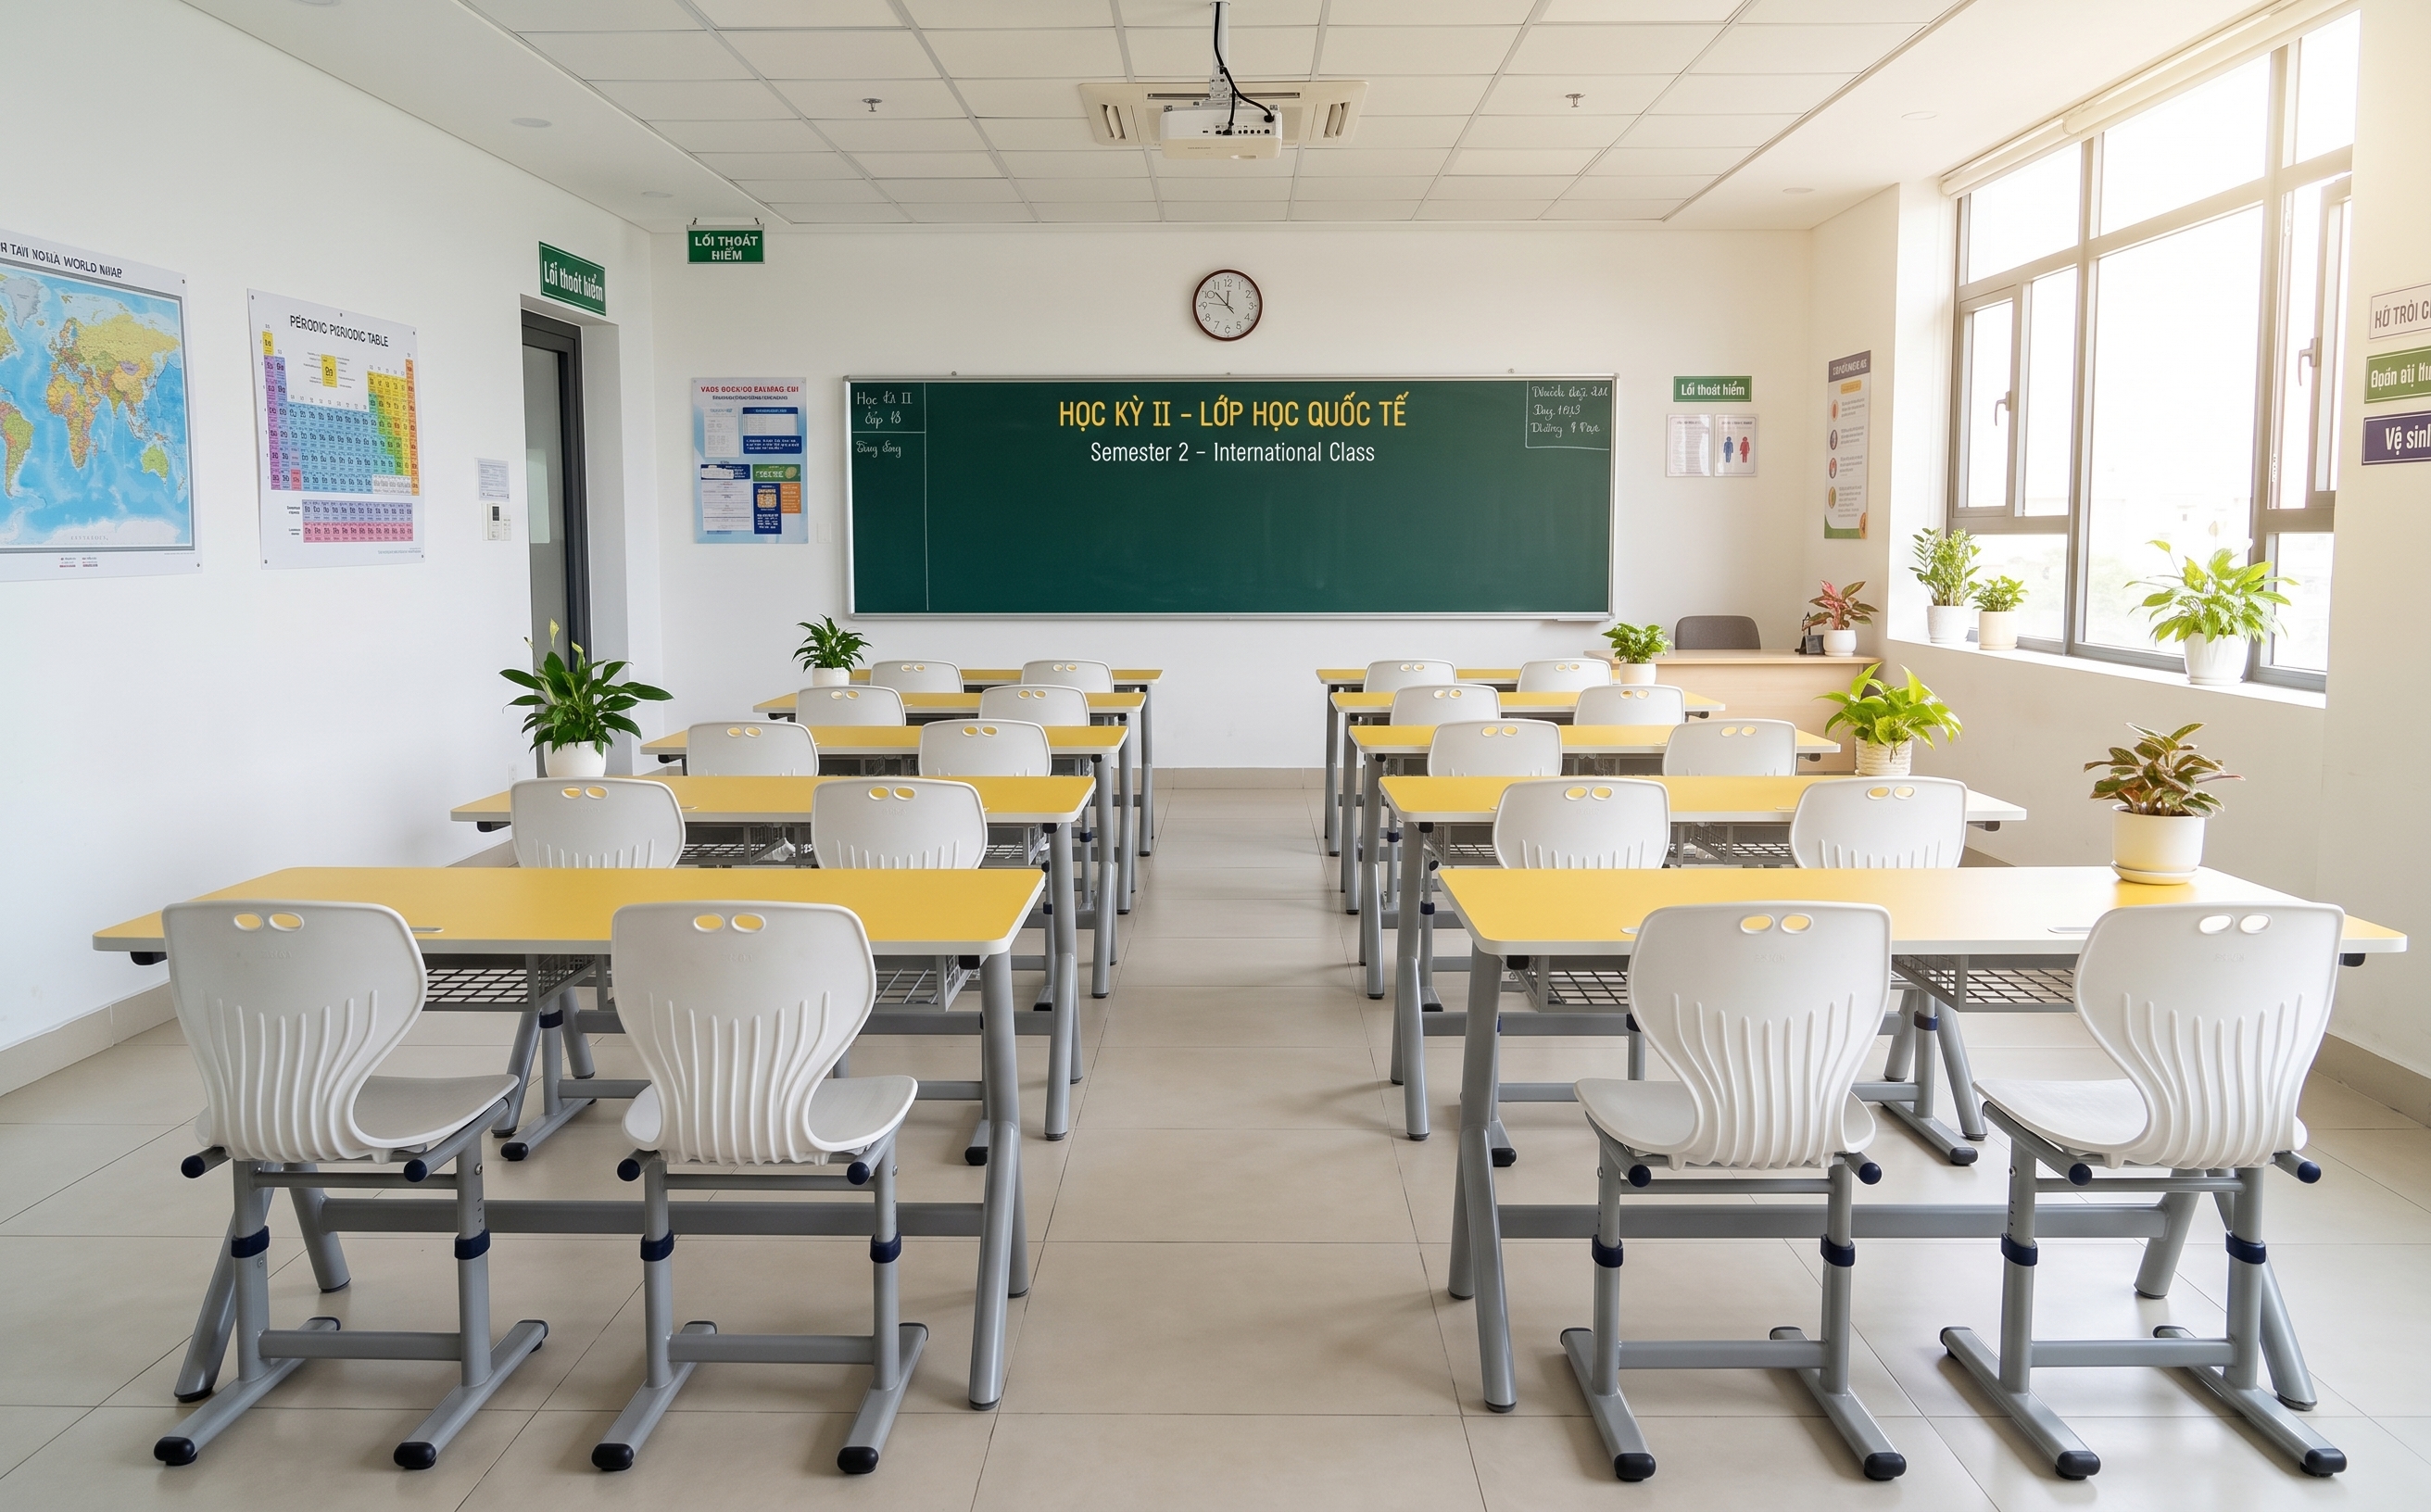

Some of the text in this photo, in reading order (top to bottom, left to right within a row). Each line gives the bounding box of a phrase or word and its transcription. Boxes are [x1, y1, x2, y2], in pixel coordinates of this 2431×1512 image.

[695, 233, 758, 246] LỐI THOÁT
[63, 256, 97, 273] WORLD
[560, 268, 582, 295] thoát
[1215, 282, 1220, 290] 11
[1224, 279, 1233, 287] 12
[1204, 290, 1216, 298] 10
[1245, 290, 1252, 298] 2
[2422, 300, 2431, 320] C
[1205, 313, 1211, 321] 8
[1244, 313, 1250, 321] 4
[1215, 321, 1220, 329] 7
[367, 332, 389, 347] TABLE
[1697, 384, 1721, 396] thoát
[857, 391, 878, 409] Học
[1059, 400, 1106, 432] HỌC
[1115, 395, 1144, 427] KỲ
[1153, 401, 1171, 427] II
[1201, 394, 1243, 427] LỚP
[1253, 400, 1299, 432] HỌC
[1307, 391, 1371, 428] QUỐC
[1379, 391, 1409, 427] TẾ
[2386, 425, 2402, 456] Vệ
[1090, 441, 1172, 461] Semester
[1178, 442, 1189, 461] 2
[1215, 441, 1321, 461] International
[1329, 441, 1375, 461] Class
